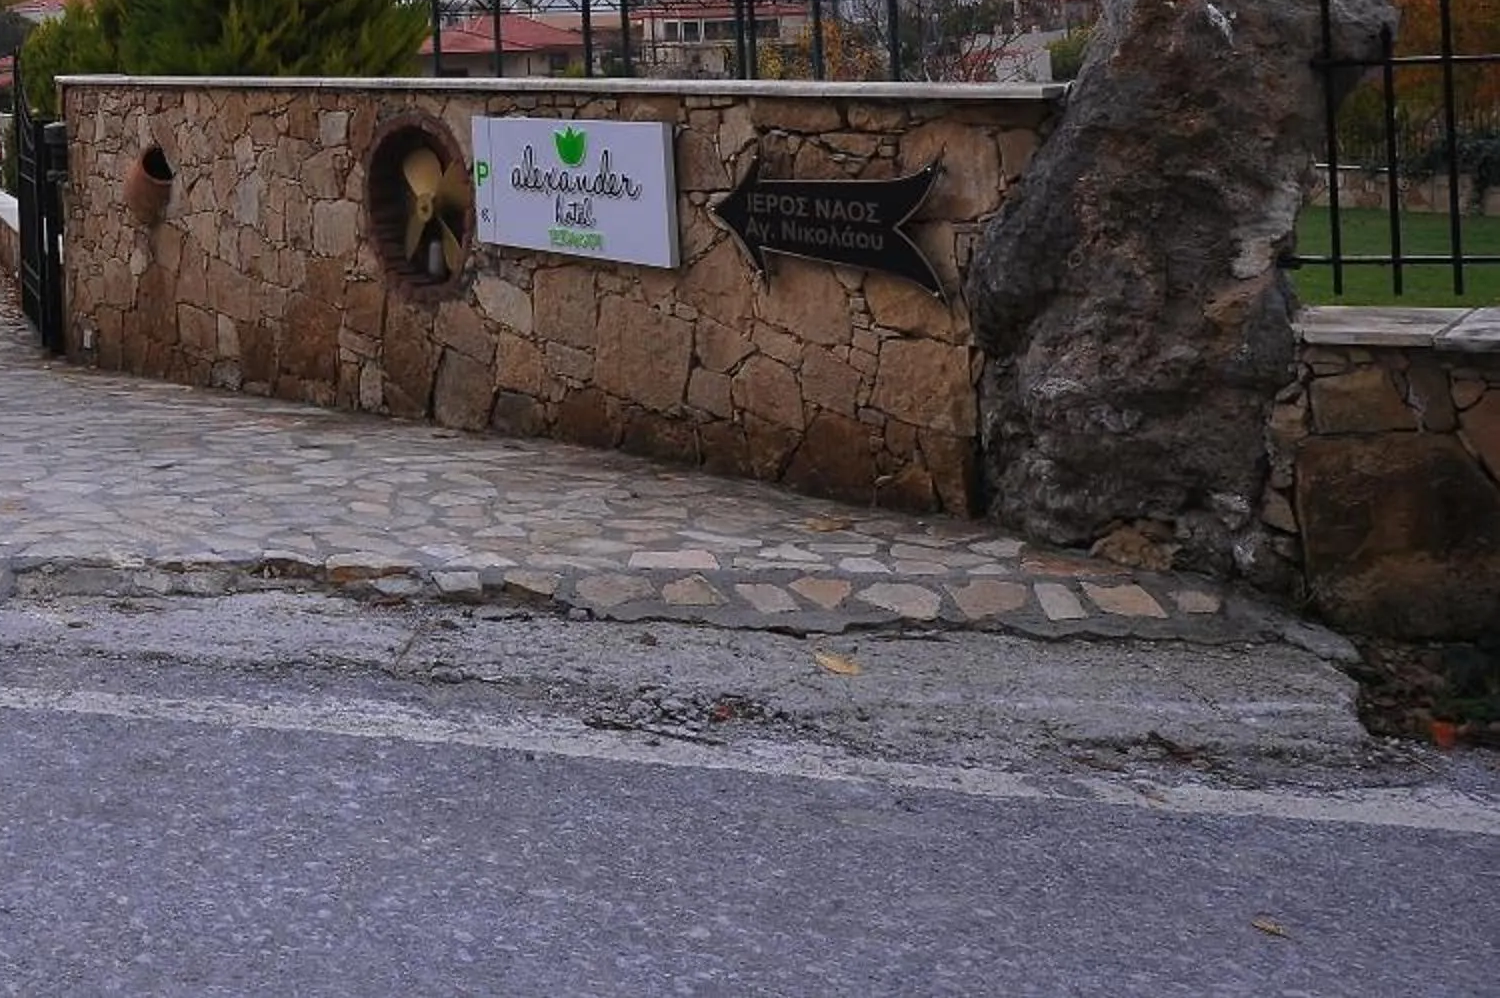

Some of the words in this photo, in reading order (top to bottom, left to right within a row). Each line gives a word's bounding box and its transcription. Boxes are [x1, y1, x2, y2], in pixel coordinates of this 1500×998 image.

[511, 144, 641, 200] alexander
[555, 194, 596, 227] hotel
[746, 193, 809, 217] ΙΕΡΟΣ
[815, 199, 881, 223] ΝΑΟΣ
[745, 216, 776, 242] Αγ.
[780, 220, 884, 250] Νικολάου
